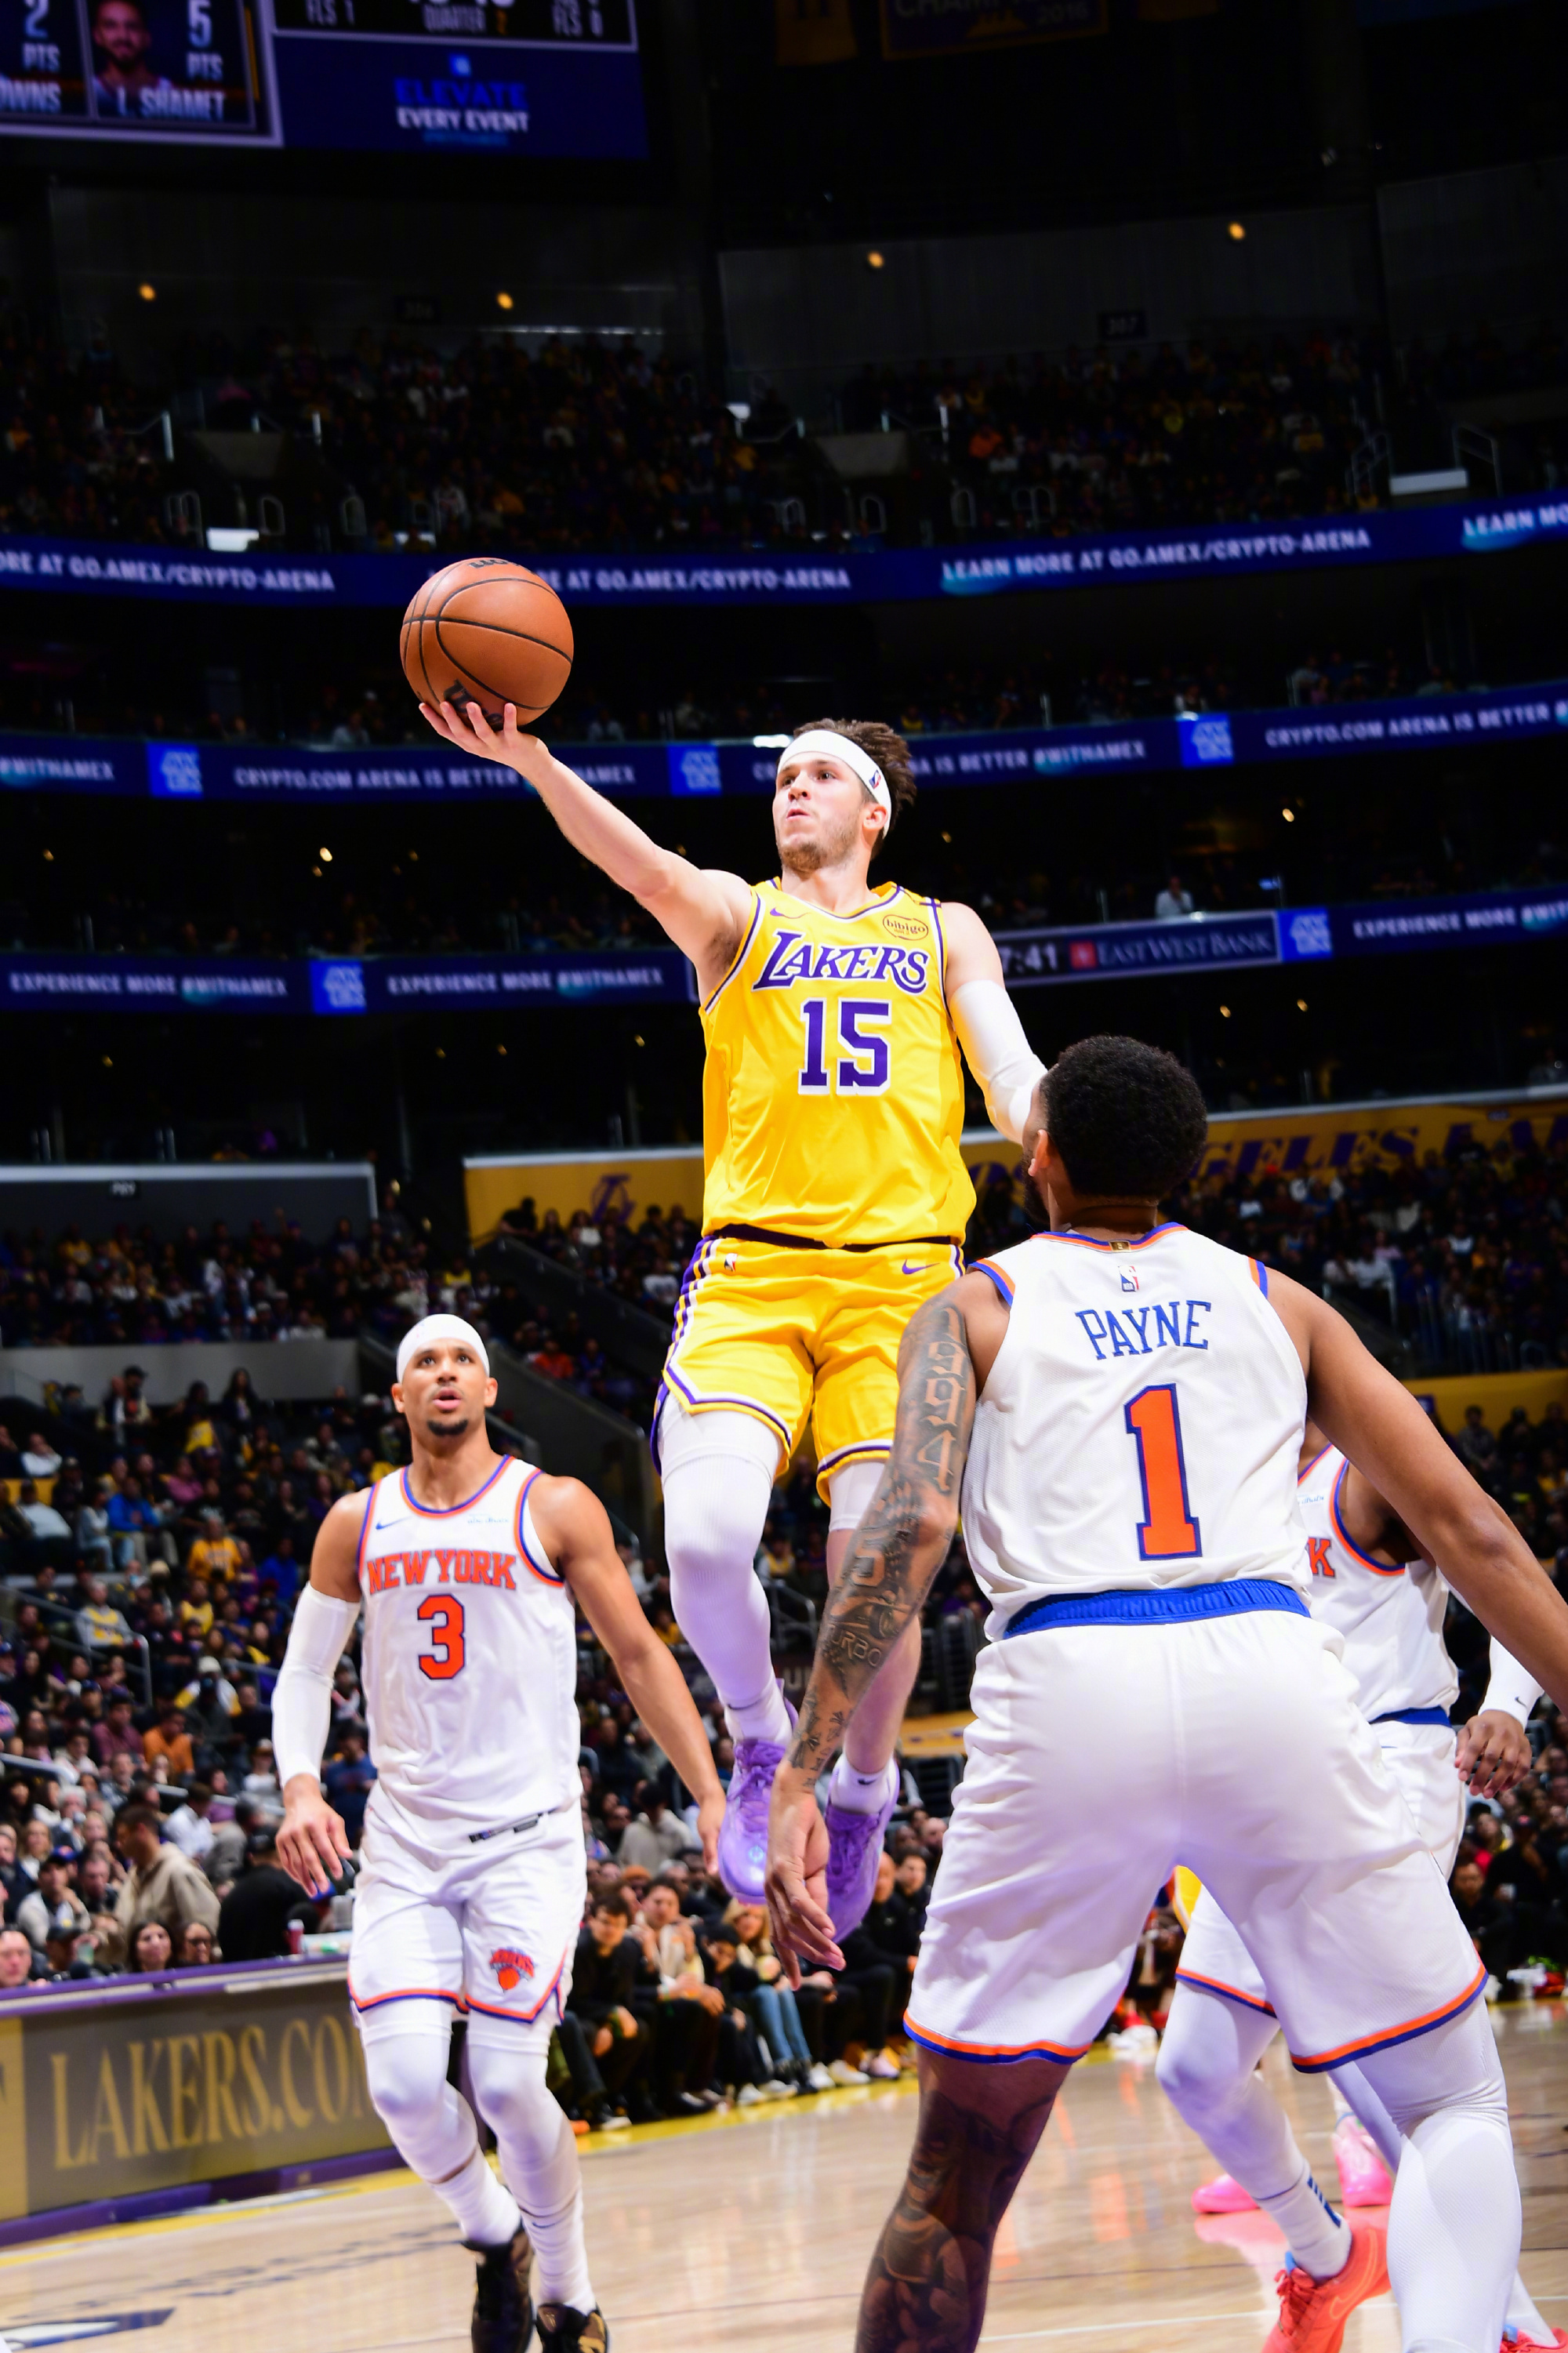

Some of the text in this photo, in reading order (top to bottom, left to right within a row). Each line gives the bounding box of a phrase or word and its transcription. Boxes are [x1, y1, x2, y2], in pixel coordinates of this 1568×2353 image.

[394, 78, 528, 109] ELEVATE
[396, 105, 528, 133] EVERY EVENT
[1463, 510, 1534, 537] LEARN
[38, 554, 64, 575] AT
[942, 557, 1011, 581] LEARN
[1014, 552, 1074, 574] MORE
[1079, 549, 1103, 570] AT
[1388, 715, 1450, 736] ARENA
[1453, 712, 1474, 730] IS
[1477, 703, 1550, 729] BETTER
[958, 749, 1029, 772] BETTER
[357, 769, 421, 789] ARENA
[423, 768, 445, 788] IS
[887, 919, 925, 935] bibigo
[1352, 913, 1461, 939] EXPERIENCE
[1464, 907, 1516, 928] MORE
[751, 928, 929, 996] LAKERS
[9, 972, 122, 993] EXPERIENCE
[125, 975, 176, 994] MORE
[387, 972, 498, 995] EXPERIENCE
[501, 971, 552, 990] MORE
[798, 997, 892, 1096] 15
[1076, 1300, 1212, 1361] PAYNE
[1123, 1382, 1203, 1561] 1
[366, 1549, 517, 1595] NEW YORK
[416, 1592, 465, 1680] 3
